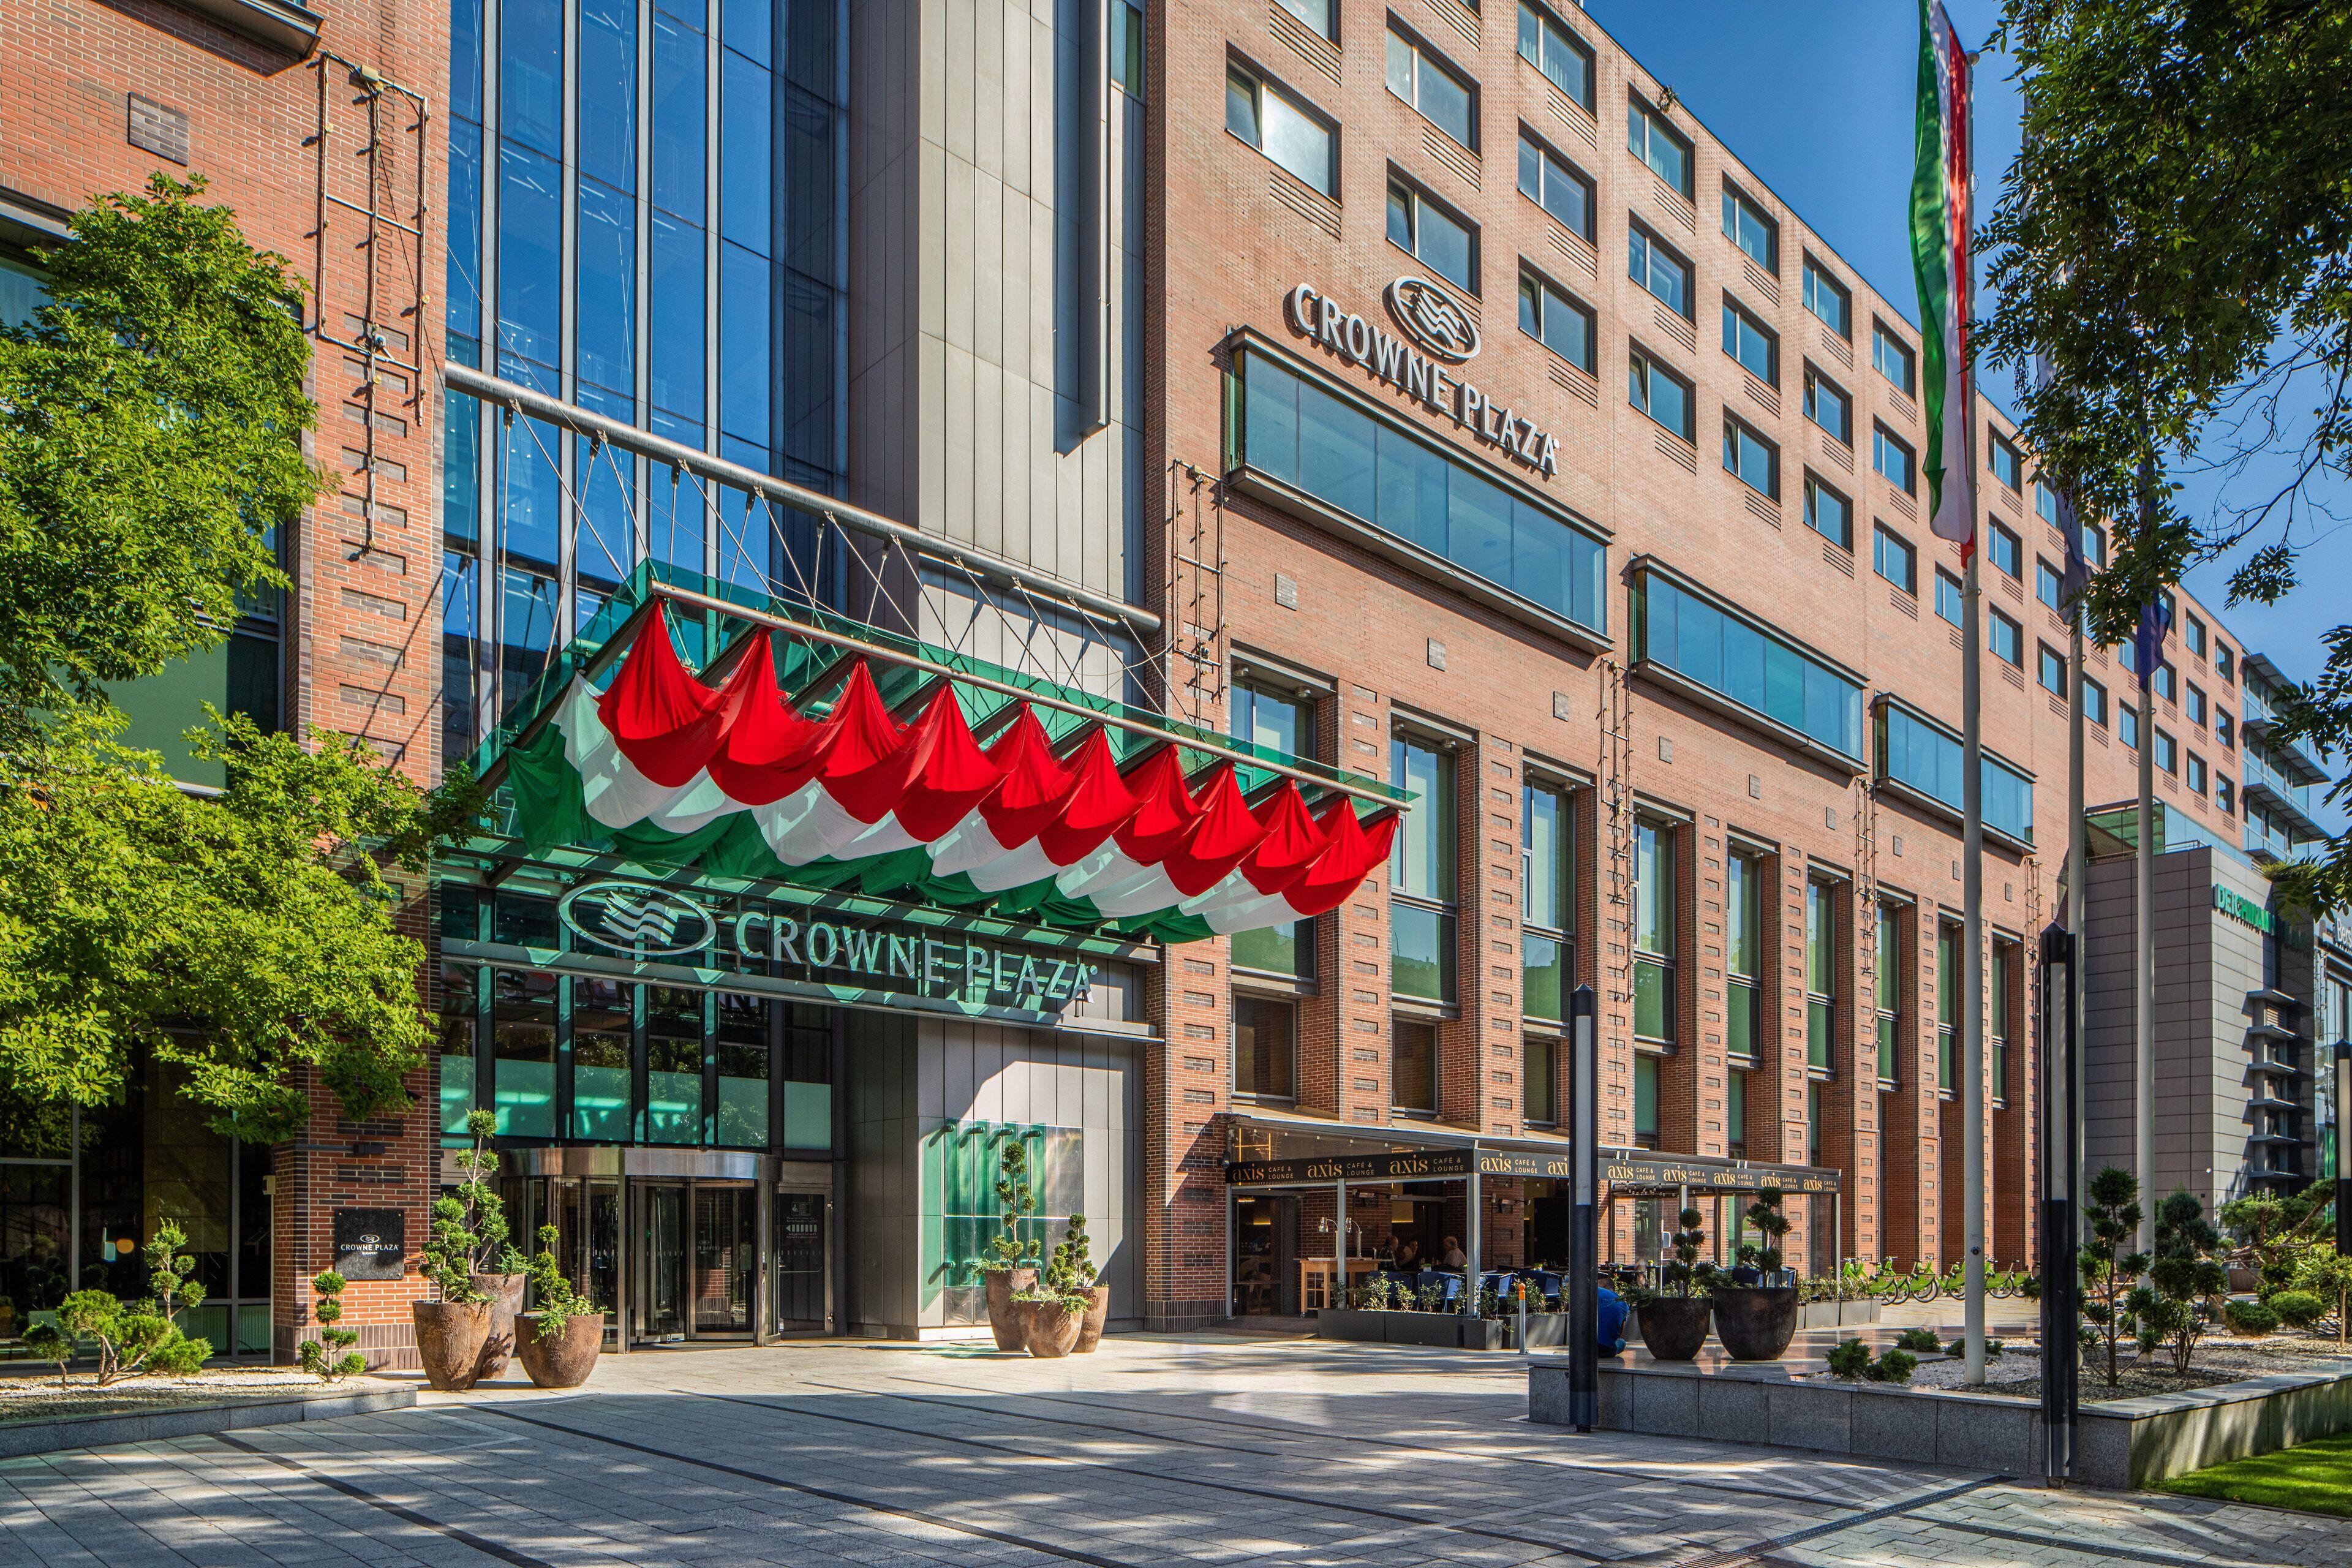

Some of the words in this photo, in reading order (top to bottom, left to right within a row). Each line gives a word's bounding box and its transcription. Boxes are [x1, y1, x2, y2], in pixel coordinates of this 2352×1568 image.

[1292, 282, 1449, 411] CROWNE
[1460, 382, 1558, 476] PLAZA
[2215, 882, 2276, 936] DEICHMANN
[736, 911, 946, 982] CROWNE
[965, 945, 1095, 1004] PLAZA
[1232, 1163, 1264, 1181] axis
[1308, 1159, 1342, 1178] axis
[1390, 1154, 1428, 1174] axis
[1480, 1153, 1512, 1174] axis
[1548, 1157, 1569, 1176] axi
[1608, 1161, 1634, 1180] axis
[1663, 1165, 1687, 1183] axis
[1714, 1169, 1736, 1186] axis
[1761, 1172, 1781, 1188] axis
[1803, 1175, 1822, 1191] axis
